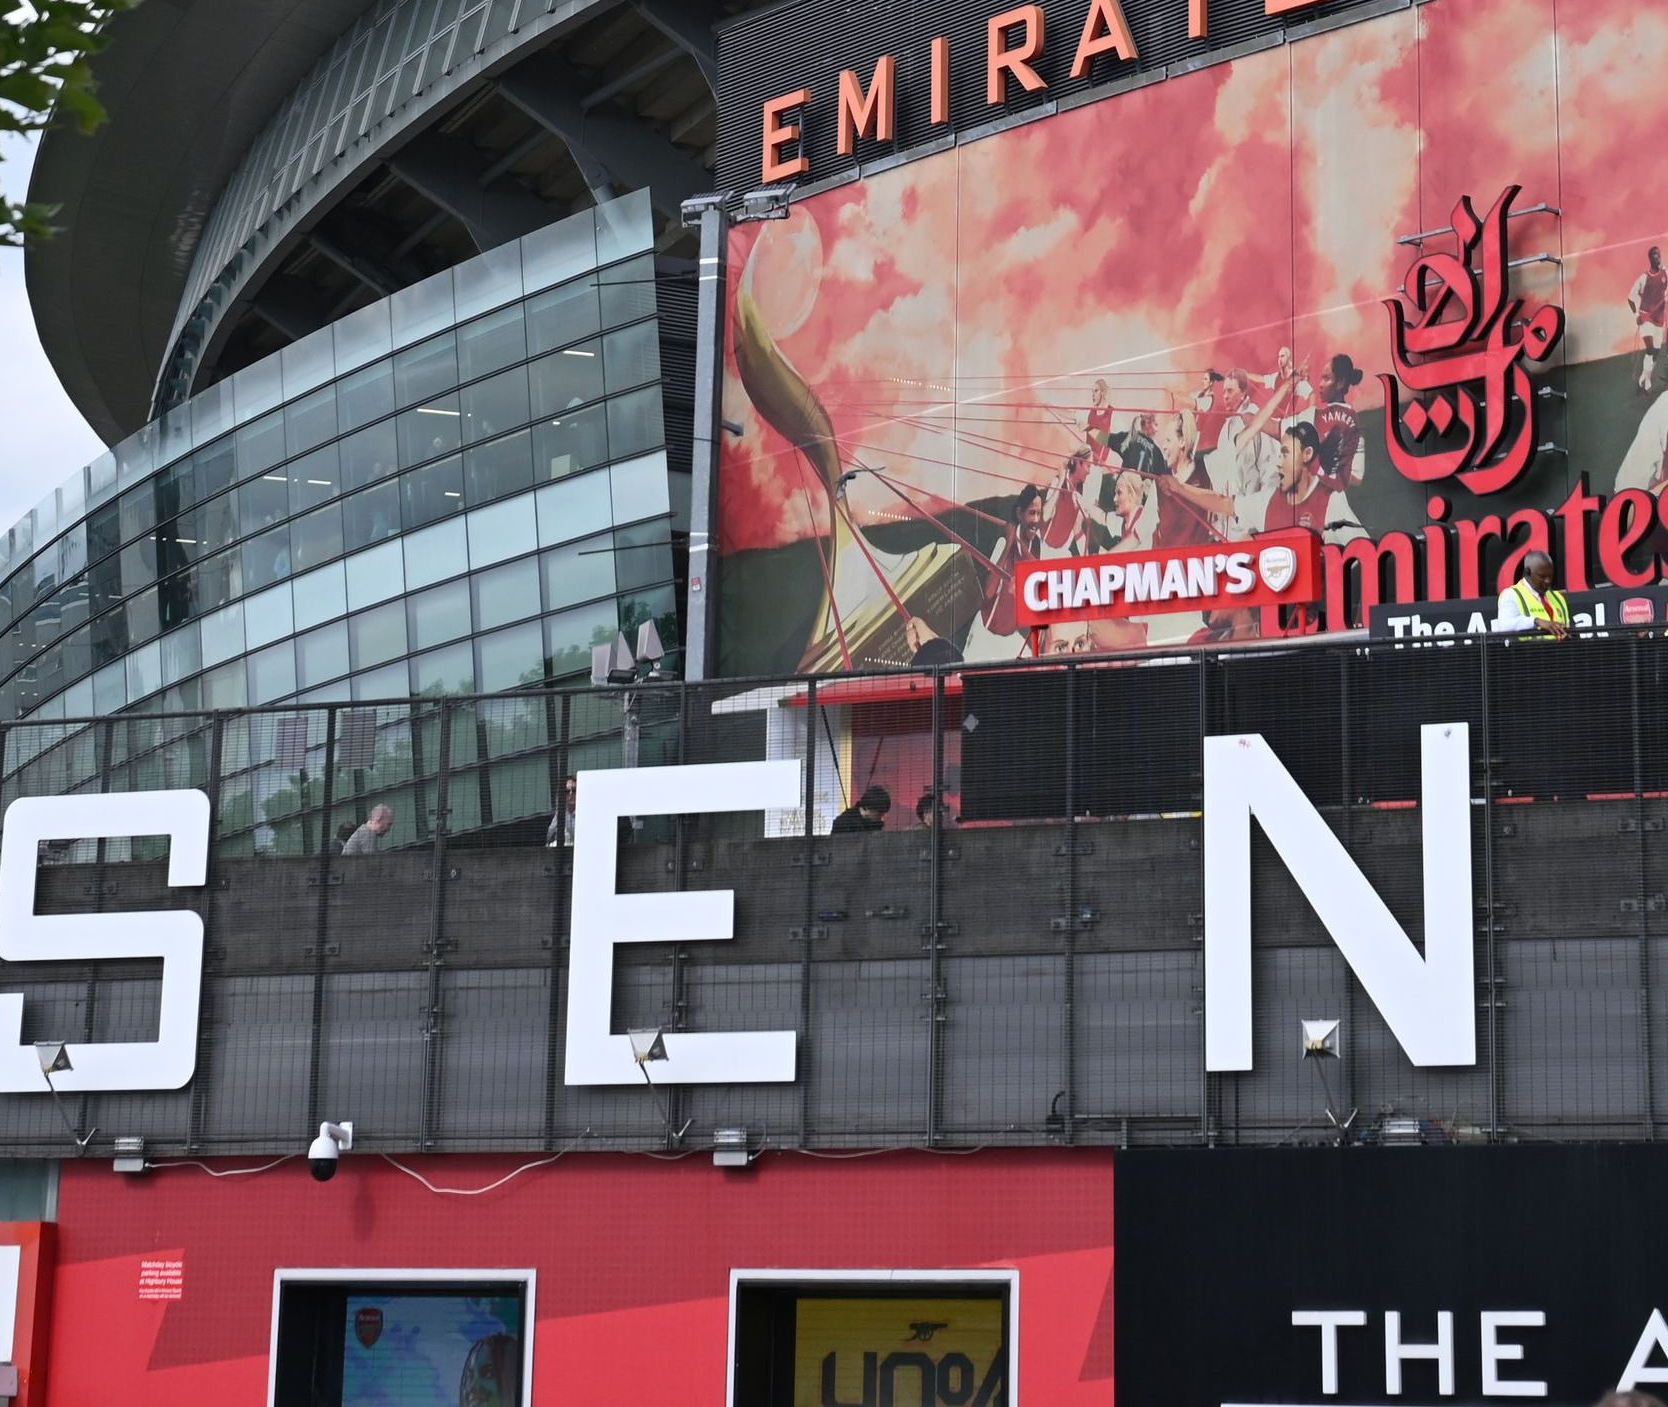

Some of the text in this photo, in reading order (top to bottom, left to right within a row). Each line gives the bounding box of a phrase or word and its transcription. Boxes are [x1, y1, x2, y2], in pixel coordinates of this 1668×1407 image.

[1321, 410, 1357, 429] YANKEY
[1023, 552, 1255, 613] CHAPMAN'S
[1387, 613, 1456, 649] The
[1290, 1309, 1547, 1396] THE
